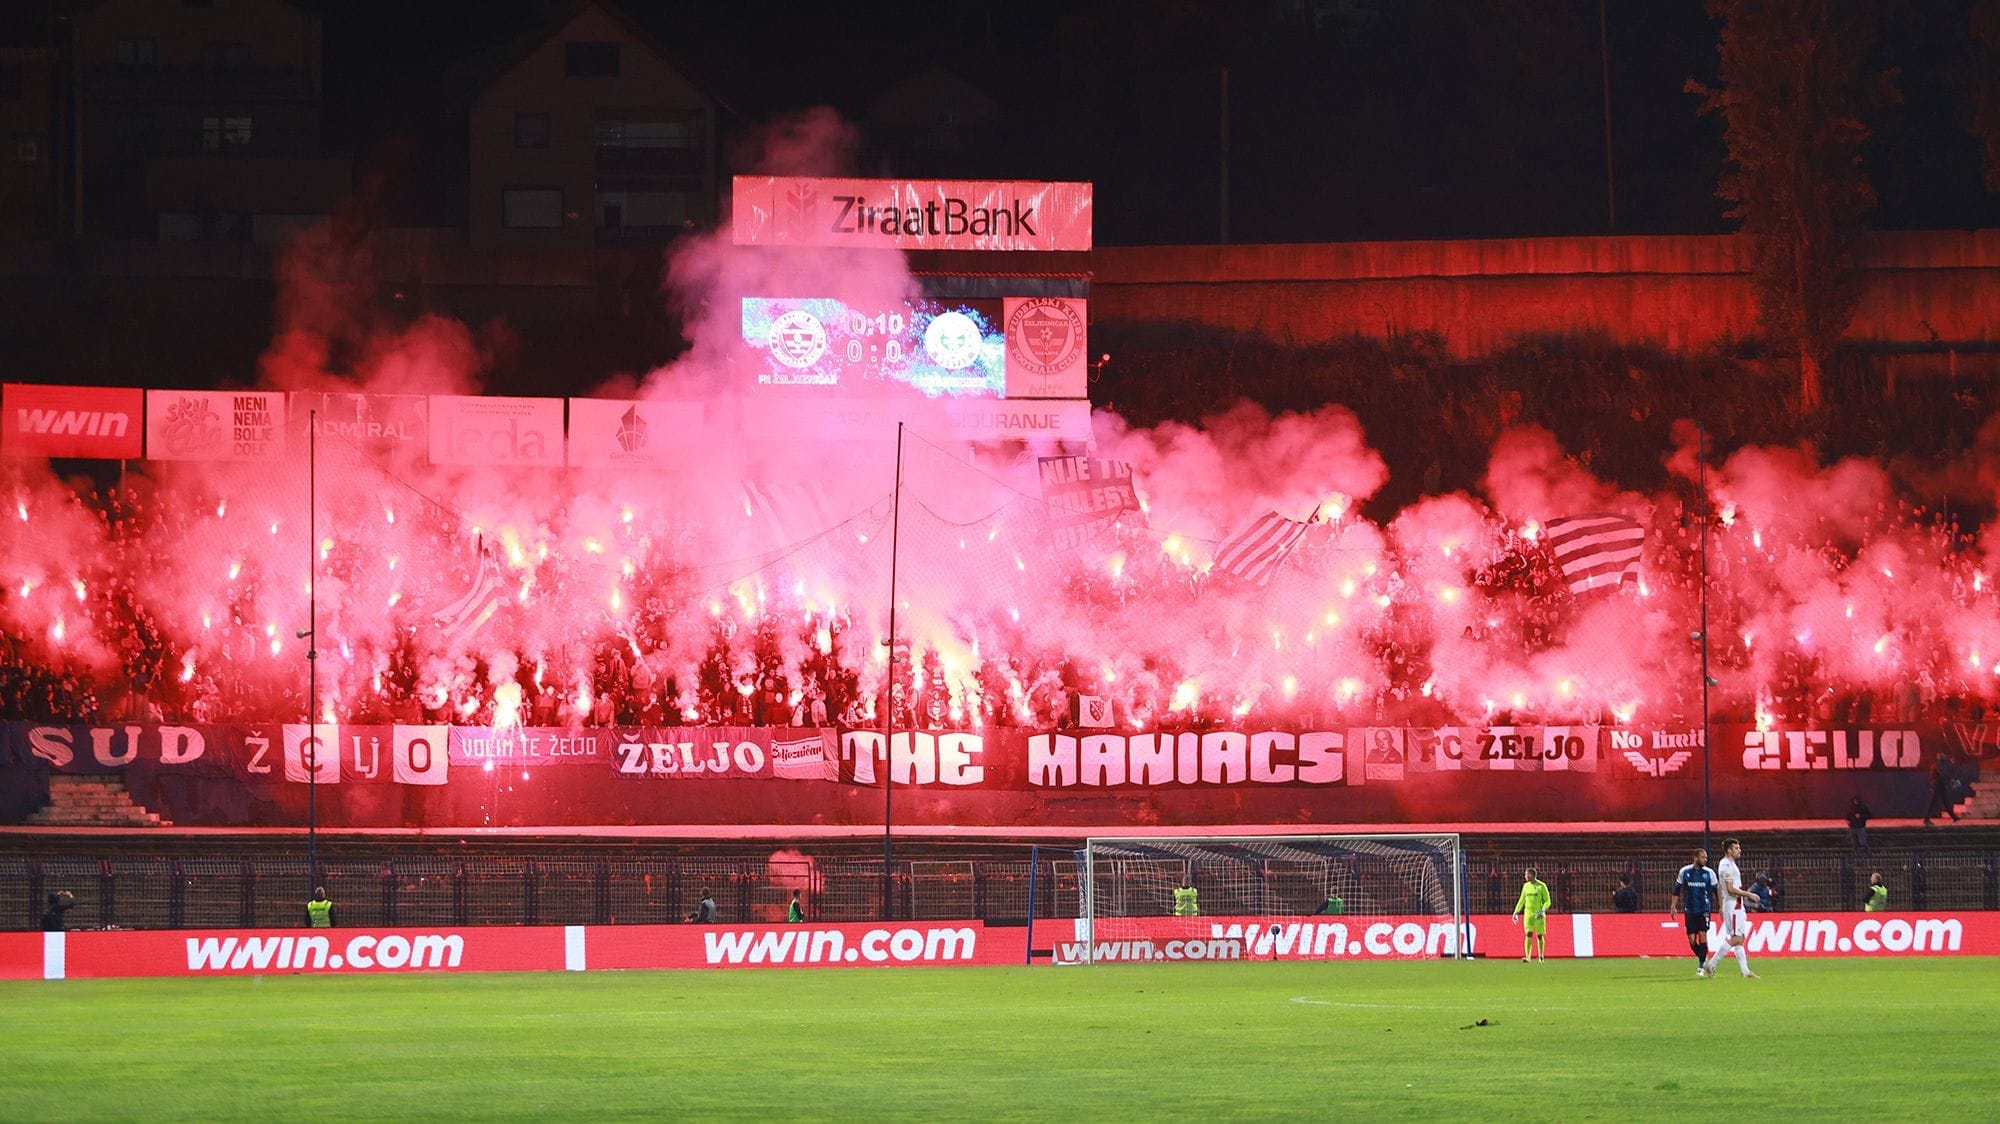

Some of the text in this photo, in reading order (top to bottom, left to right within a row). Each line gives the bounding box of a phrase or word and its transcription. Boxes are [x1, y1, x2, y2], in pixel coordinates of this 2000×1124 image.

[832, 196, 1036, 236] ZiraatBank
[1008, 297, 1083, 334] FUDBALSKI KLUB
[847, 340, 862, 362] 0
[886, 340, 901, 362] 0
[1012, 347, 1059, 374] FOOTBALL
[233, 397, 267, 411] MENI
[233, 412, 272, 426] NEMA
[17, 407, 129, 437] wwin
[233, 427, 273, 441] BOLJE
[303, 421, 414, 440] ADMIRAL
[1041, 456, 1091, 486] NIJE
[28, 726, 206, 767] SUD
[462, 737, 513, 757] VOLIM
[549, 735, 597, 756] ŽELJO
[617, 733, 765, 773] ŽELJO
[1419, 728, 1585, 763] FC ŽELJO
[1610, 730, 1643, 749] No
[841, 730, 1344, 787] THE MANIACS
[186, 934, 465, 970] wwin.com
[704, 927, 977, 963] wwin.com
[1061, 939, 1241, 960] wwin.com
